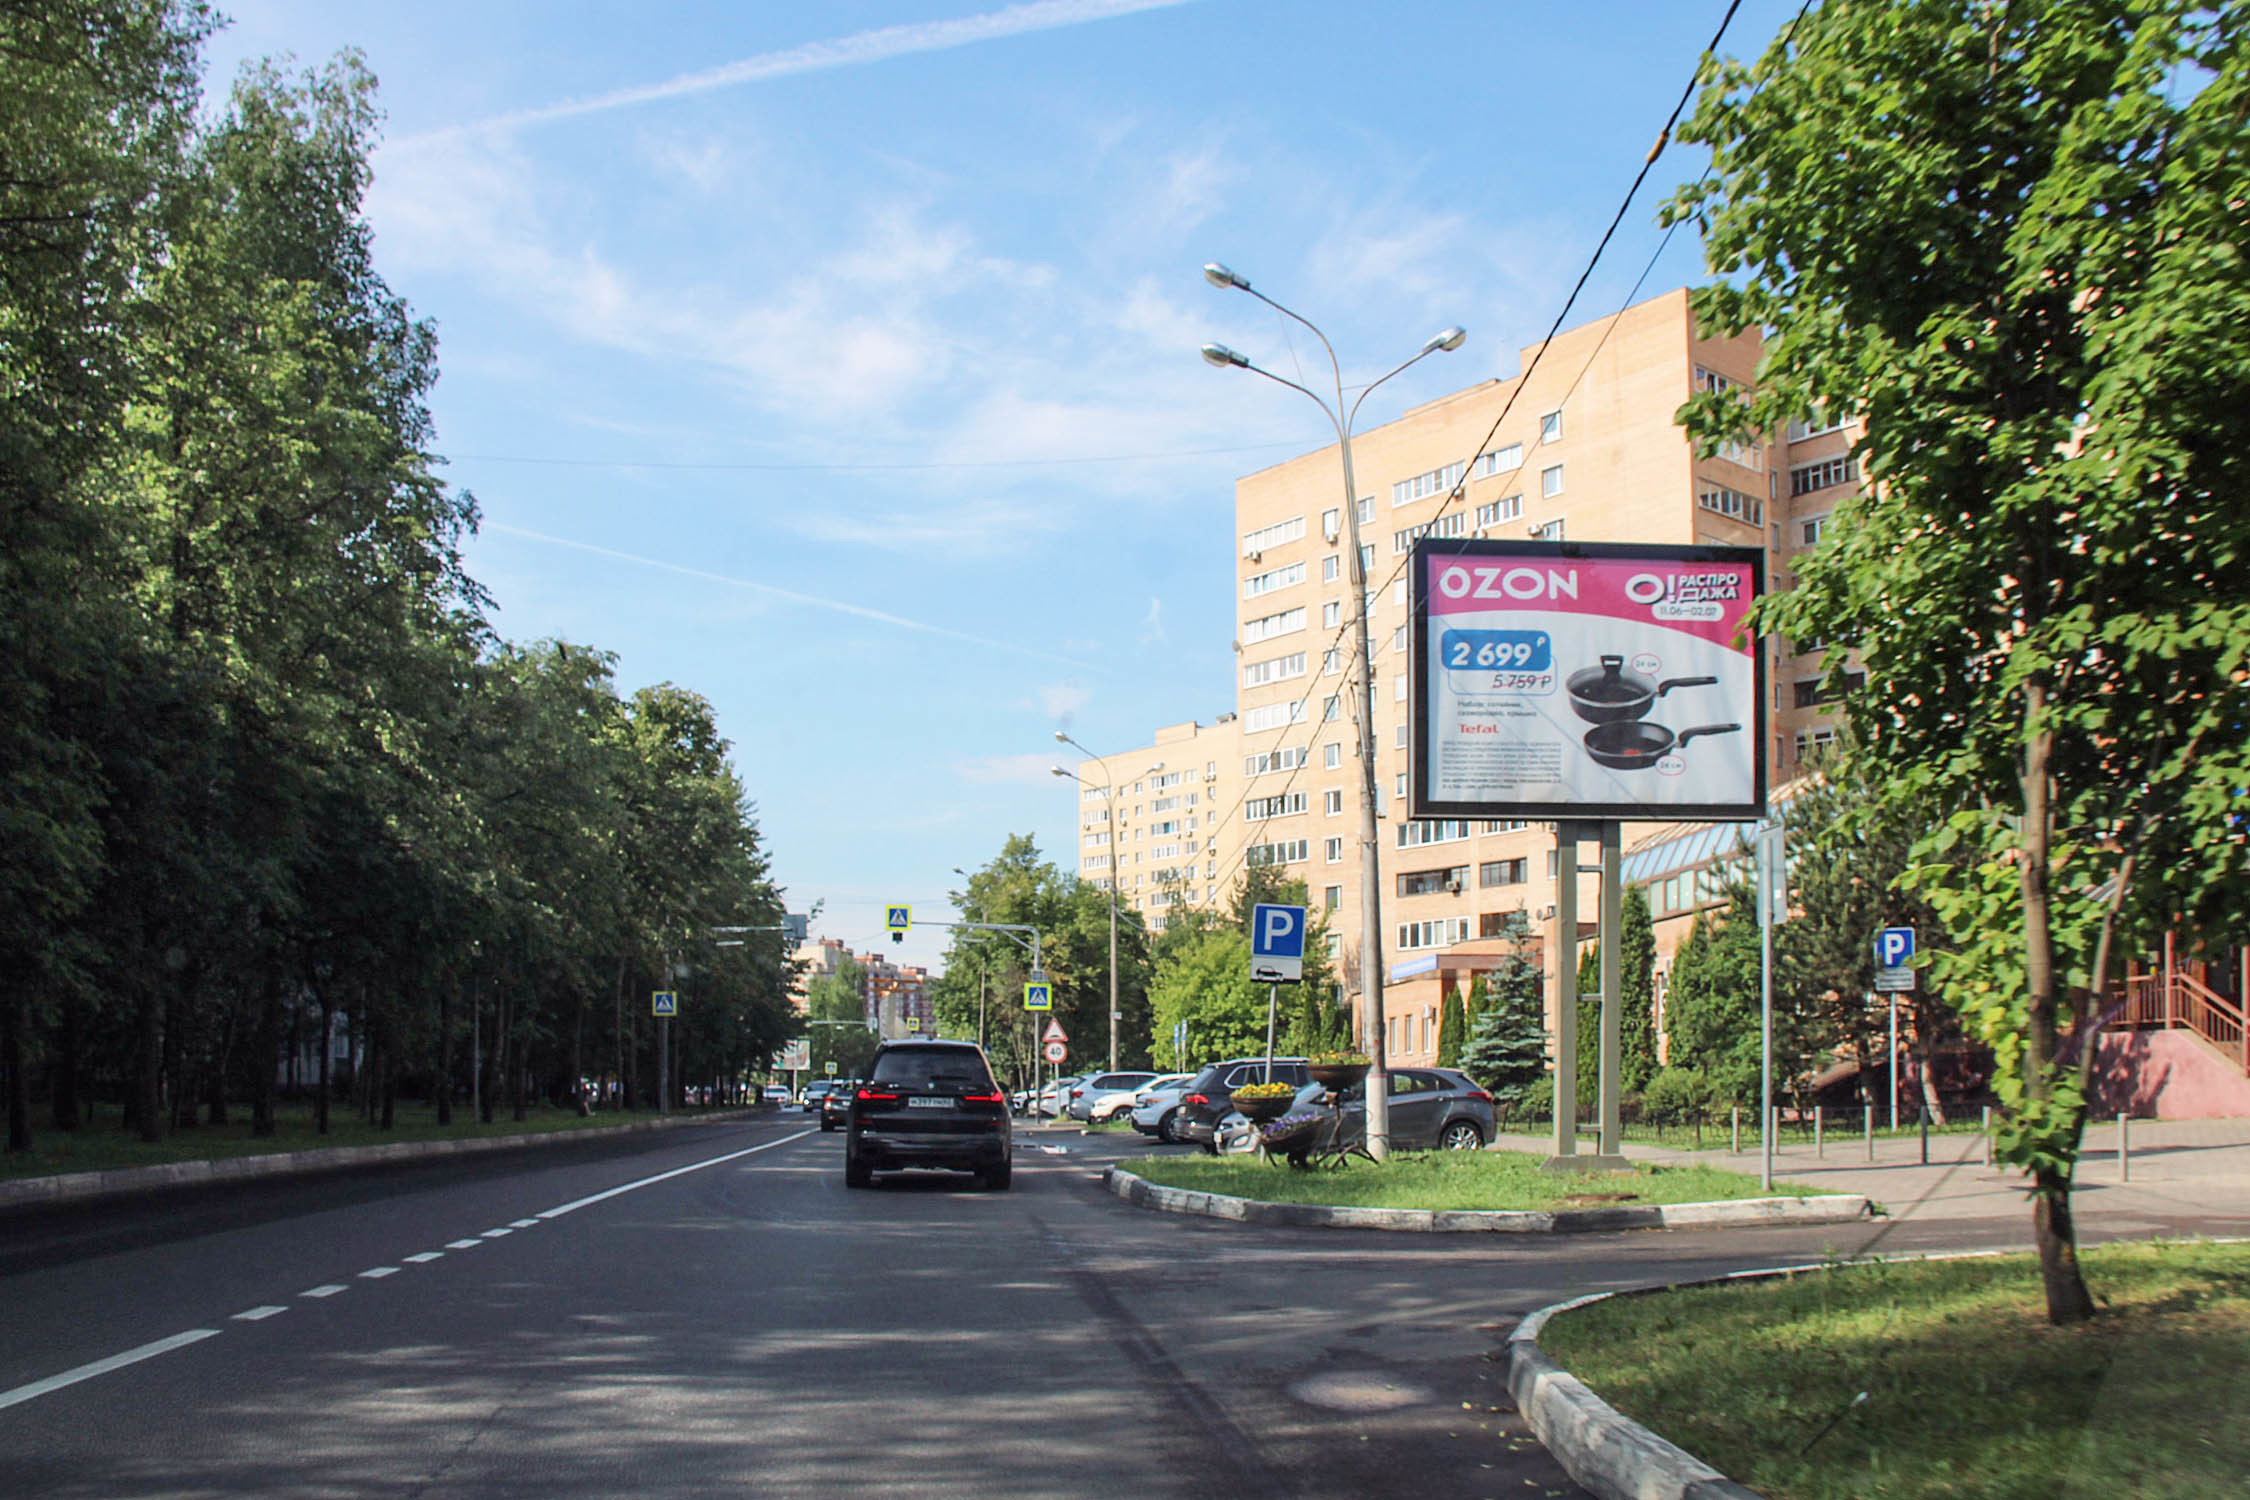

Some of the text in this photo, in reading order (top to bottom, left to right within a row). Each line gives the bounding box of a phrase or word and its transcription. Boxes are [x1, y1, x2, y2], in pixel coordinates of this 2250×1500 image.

[1439, 566, 1578, 600] OZON
[1679, 573, 1740, 587] РАСПРО
[1678, 587, 1738, 602] ДАЖА
[1451, 641, 1472, 666] 2
[1477, 642, 1532, 666] 699
[1493, 674, 1504, 688] 5
[1507, 674, 1536, 689] 759
[1264, 909, 1294, 951] P
[1885, 933, 1905, 965] P
[1050, 1047, 1062, 1056] 40
